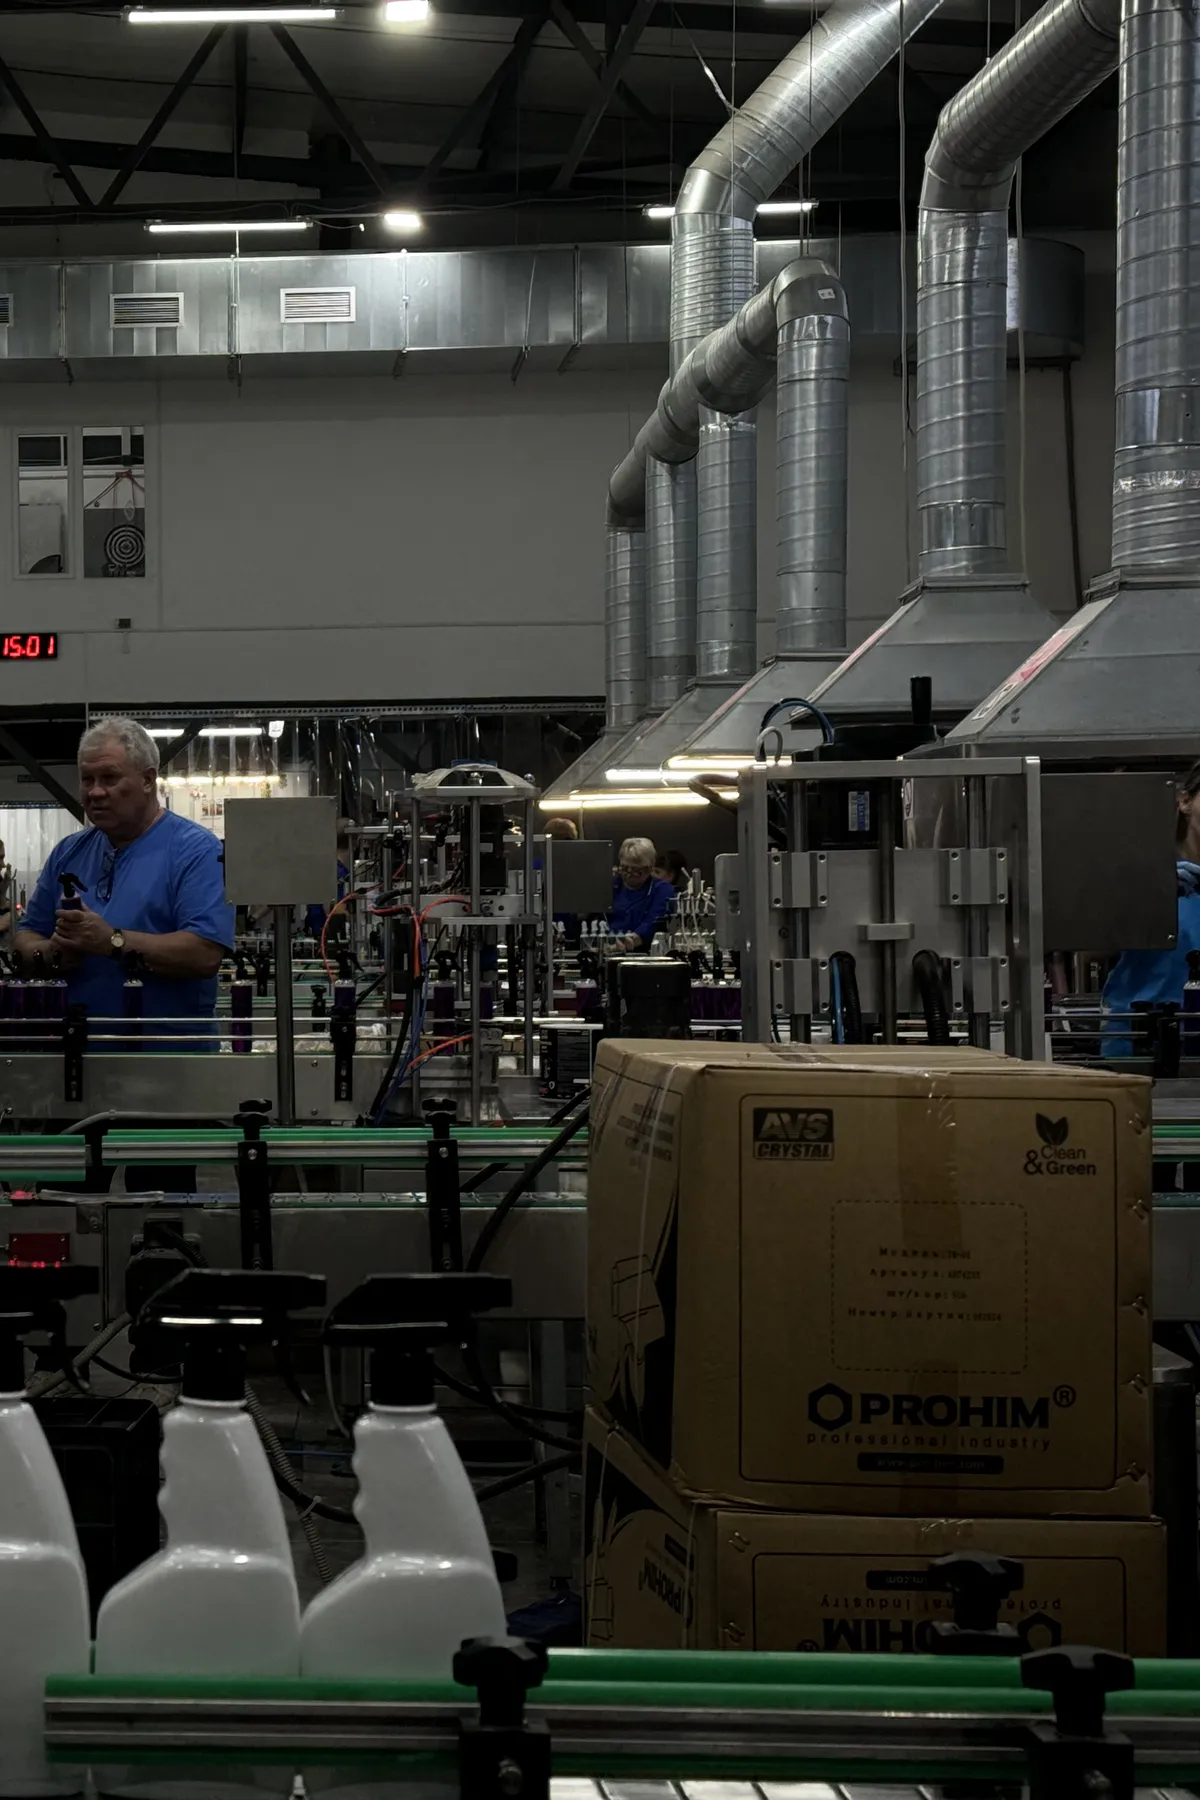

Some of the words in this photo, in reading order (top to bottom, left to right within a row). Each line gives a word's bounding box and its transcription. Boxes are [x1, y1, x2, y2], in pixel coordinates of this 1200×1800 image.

[758, 1111, 829, 1140] AVS
[757, 1143, 831, 1158] CRYSTAL
[1041, 1145, 1086, 1160] Clean
[1046, 1162, 1096, 1176] Green
[807, 1432, 948, 1447] professional
[961, 1434, 1050, 1451] industry
[924, 1598, 1061, 1610] profenal
